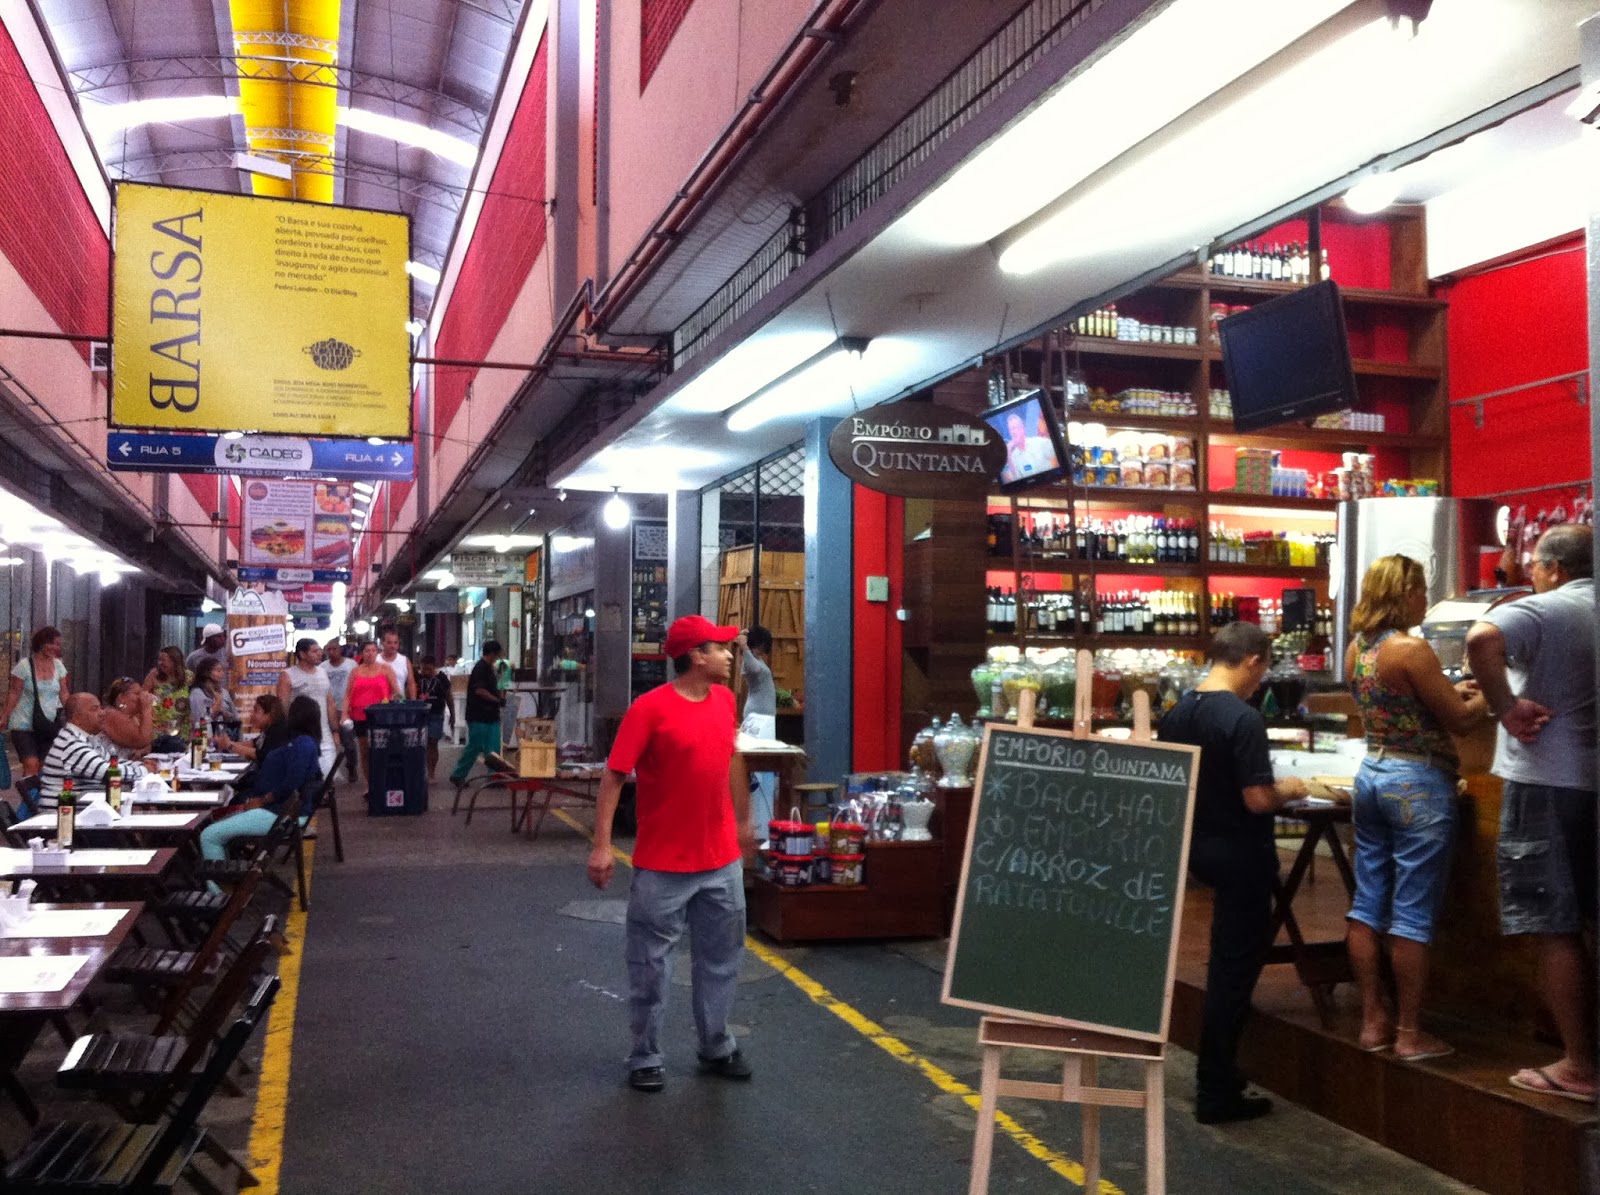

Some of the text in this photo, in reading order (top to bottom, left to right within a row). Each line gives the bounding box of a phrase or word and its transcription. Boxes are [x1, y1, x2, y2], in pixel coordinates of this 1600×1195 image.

[287, 216, 309, 226] Barsa
[332, 222, 363, 232] cozinha
[305, 230, 340, 241] povoada
[341, 234, 355, 242] por
[275, 238, 313, 248] cordeiros
[363, 247, 381, 255] com
[275, 248, 302, 258] direito
[309, 251, 328, 260] roda
[329, 254, 340, 262] de
[341, 255, 365, 264] choro
[366, 258, 382, 267] que
[328, 263, 349, 274] agito
[350, 266, 390, 277] dominical
[149, 207, 203, 413] BARSA
[851, 417, 932, 440] EMPÓRIO
[140, 445, 182, 456] RUA 5
[249, 447, 303, 461] CADEG
[345, 452, 385, 464] RUA 4
[851, 441, 987, 477] QUINTANA
[203, 467, 253, 476] MANTENHA
[264, 469, 295, 477] CADEG
[296, 470, 323, 479] LIMPO
[247, 660, 287, 668] Novembro
[994, 737, 1187, 781] EMPÓRIO QUINTANA
[1014, 771, 1180, 826] BACALHAU
